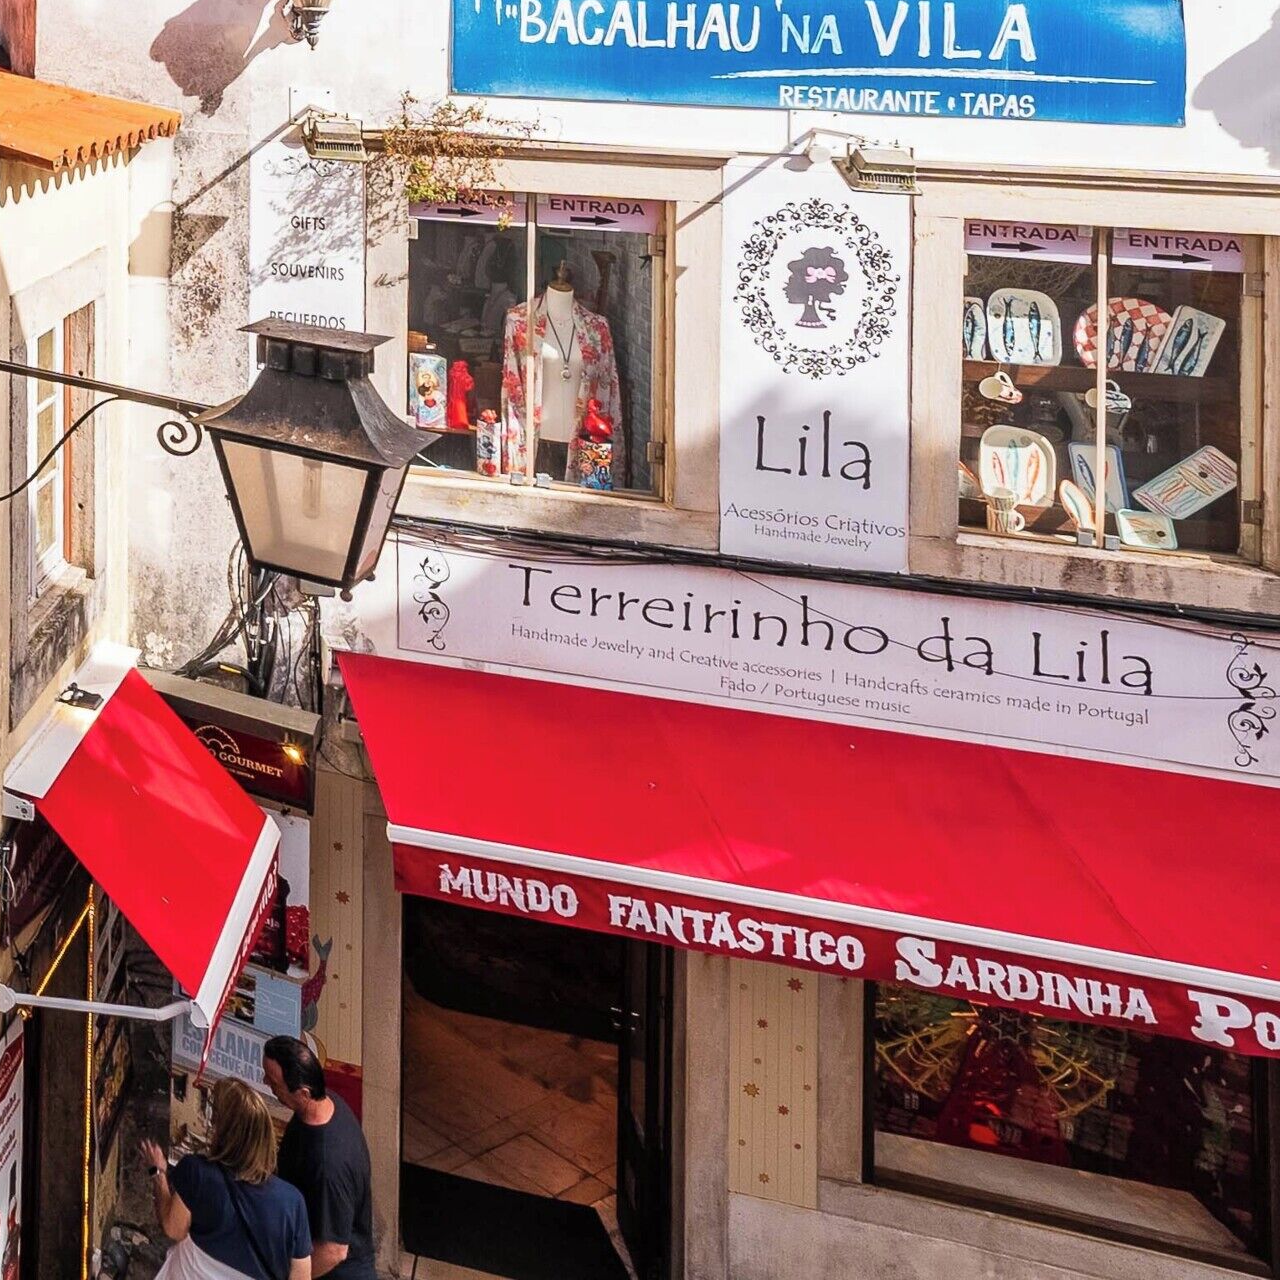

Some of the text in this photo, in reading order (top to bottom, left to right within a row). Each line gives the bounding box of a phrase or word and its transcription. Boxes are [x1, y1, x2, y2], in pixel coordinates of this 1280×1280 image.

[781, 13, 844, 55] NA
[864, 0, 1037, 62] VILA
[779, 84, 1035, 118] RESTAURANTE TAPAS
[290, 215, 326, 230] GIFTS
[550, 198, 646, 216] ENTRADA
[968, 222, 1077, 242] ENTRADA
[1129, 234, 1242, 253] ENTRADA
[271, 262, 345, 281] SOUVENIRS
[755, 409, 872, 490] Lila
[723, 502, 906, 539] Acessórios Criativos
[754, 523, 872, 552] Handmade Jewelry
[508, 563, 1153, 696] Terreirinho da Lila
[511, 623, 588, 648] Handmade
[591, 636, 645, 660] Jewelry
[648, 646, 675, 662] and
[679, 649, 739, 671] Creative
[742, 661, 823, 682] accessories
[845, 672, 929, 697] Handcrafts
[933, 685, 1001, 705] ceramics
[1006, 695, 1051, 714] made
[1056, 701, 1071, 715] in
[1078, 703, 1149, 727] Portugal
[720, 675, 757, 694] Fado
[775, 683, 860, 708] Portuguese
[865, 698, 911, 715] music
[219, 751, 284, 778] GOURMET
[438, 863, 579, 918] MUNDO
[607, 892, 867, 971] FANTÁSTICO
[894, 936, 1159, 1025] SARDINHA
